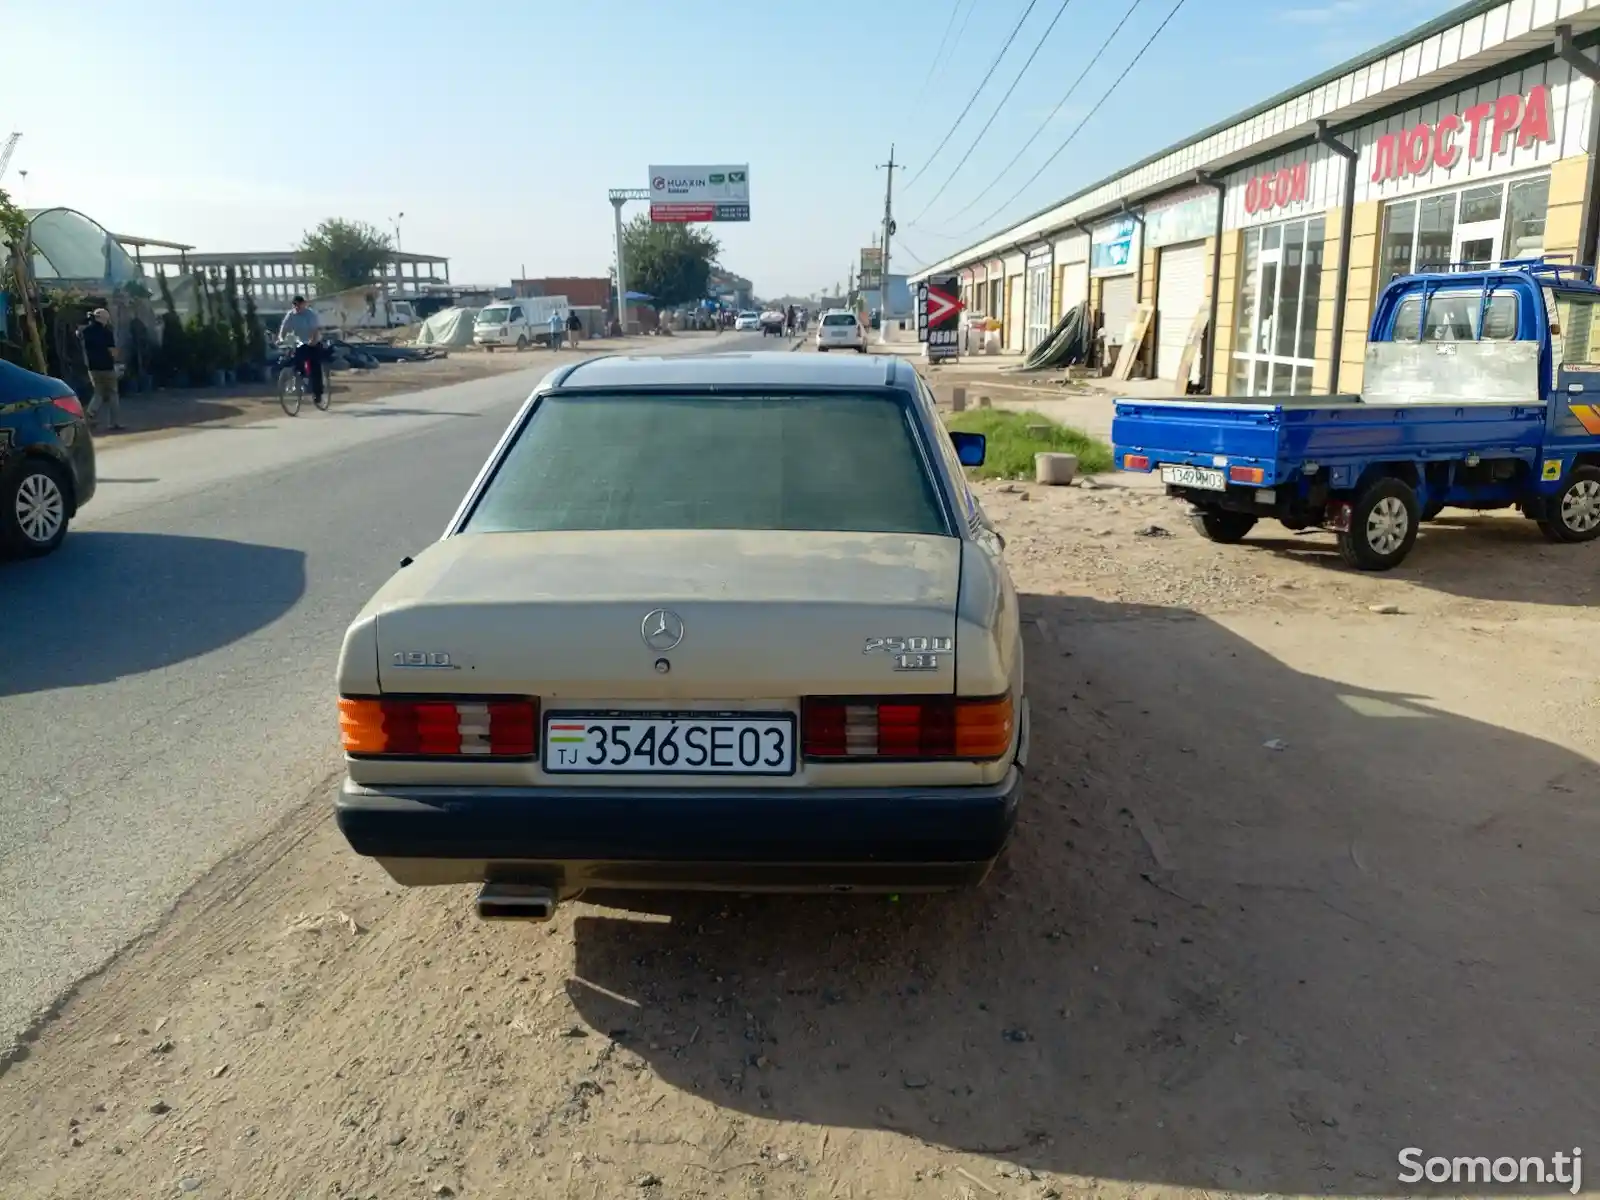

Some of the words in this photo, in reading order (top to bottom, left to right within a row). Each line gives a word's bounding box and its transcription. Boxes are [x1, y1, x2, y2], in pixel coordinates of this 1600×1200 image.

[1371, 84, 1556, 185] ЛЮСТРА
[667, 179, 705, 187] HUAXIN
[1244, 161, 1310, 214] ОБОИ
[557, 749, 578, 765] TJ
[586, 725, 785, 767] 3546SE03
